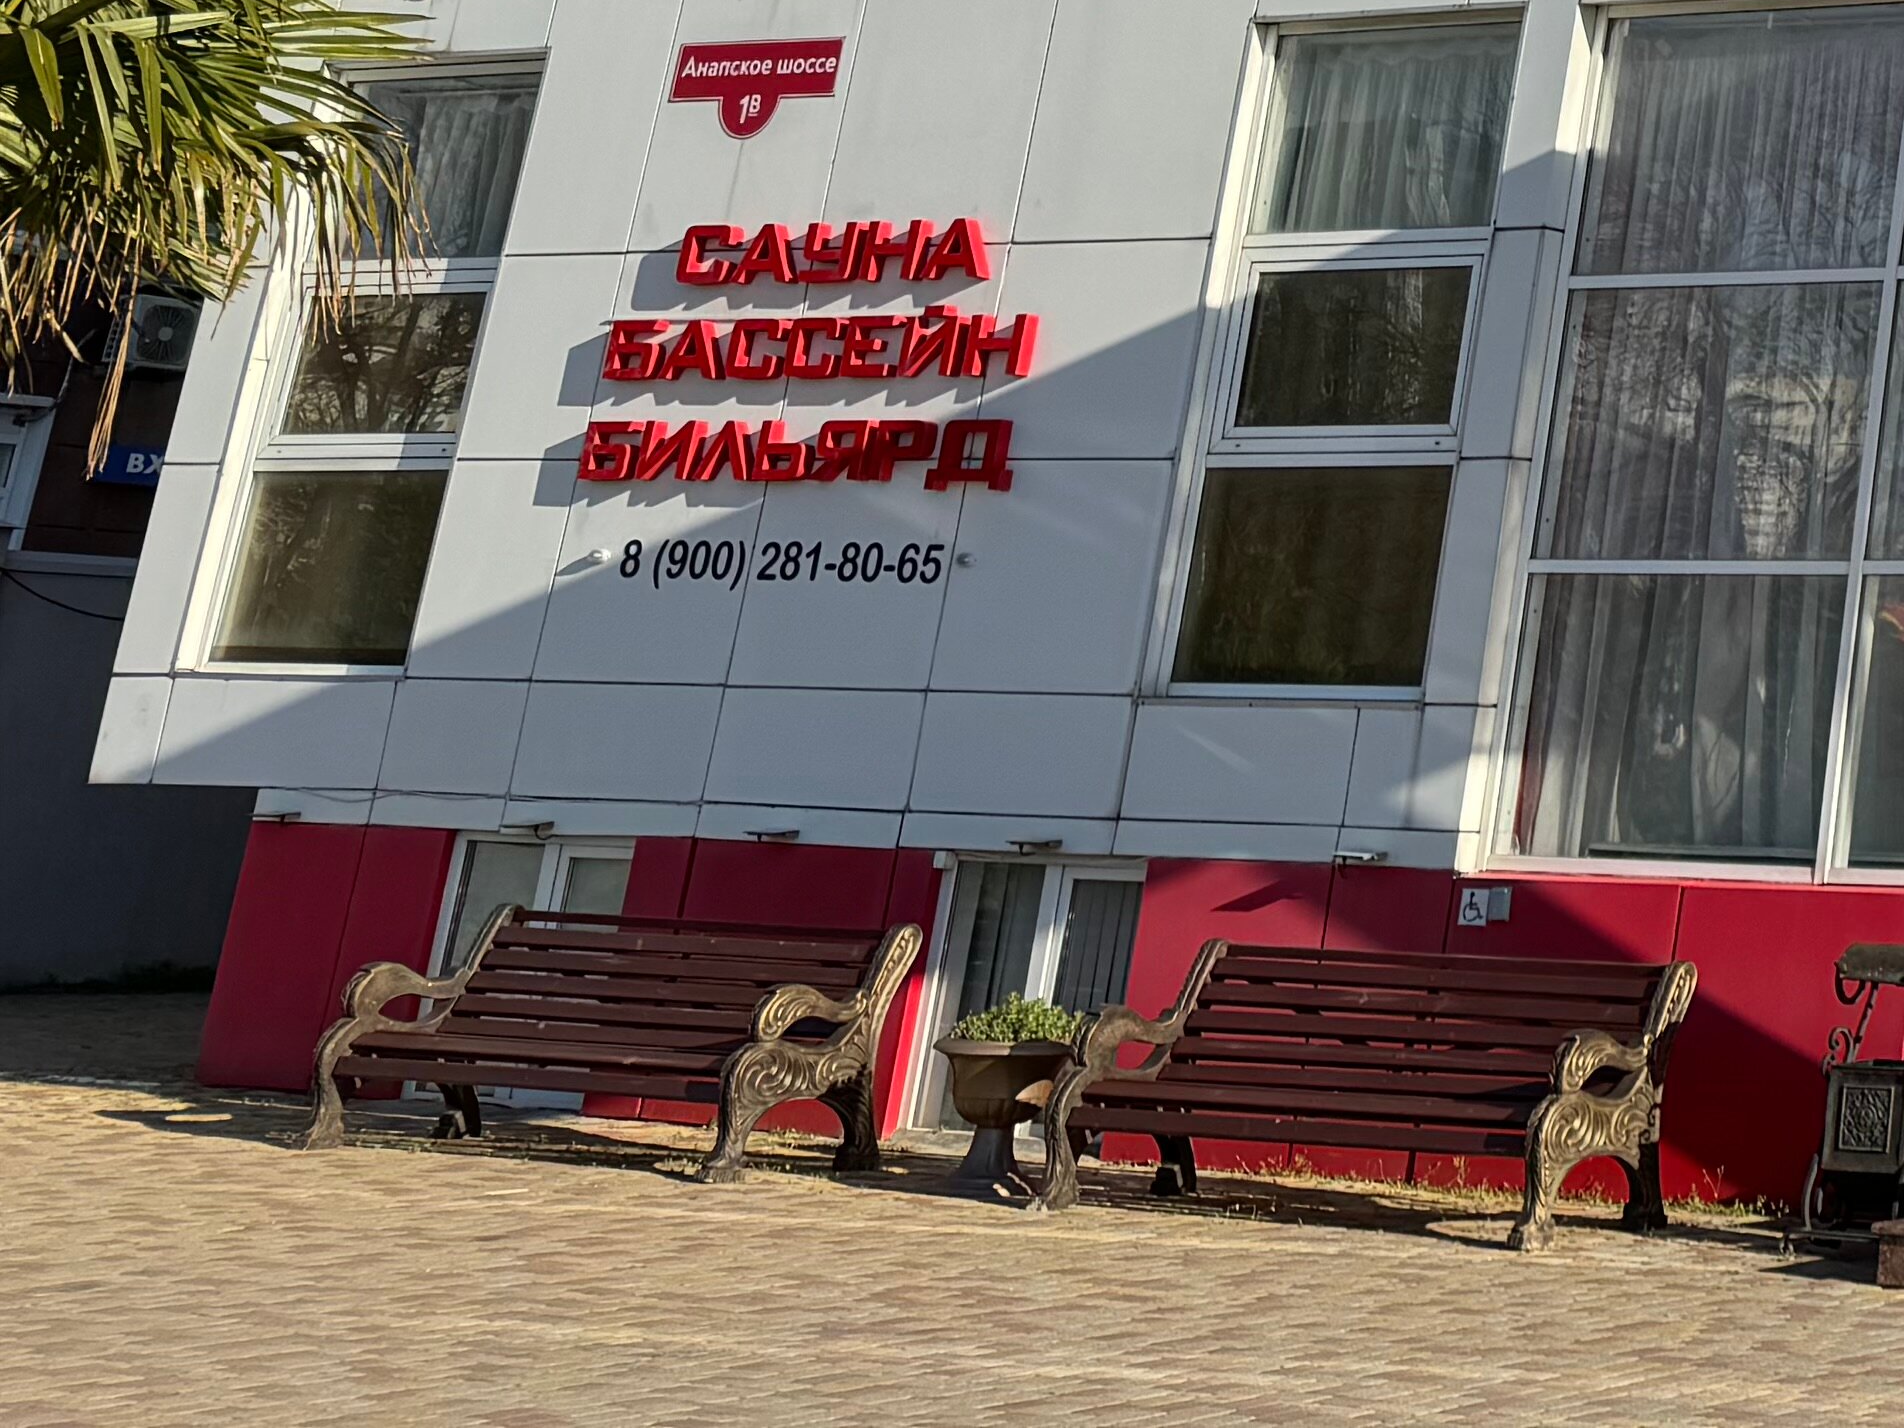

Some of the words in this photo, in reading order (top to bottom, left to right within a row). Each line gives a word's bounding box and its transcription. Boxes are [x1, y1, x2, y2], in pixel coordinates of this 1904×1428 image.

[681, 56, 771, 77] Анапское
[777, 57, 836, 74] шоссе
[675, 218, 990, 284] САУНА
[602, 305, 1040, 381] БАССЕЙН
[577, 419, 1013, 492] БИЛЬЯРД
[620, 540, 641, 578] 8
[653, 540, 747, 590] (900)
[756, 541, 945, 584] 281-80-65
